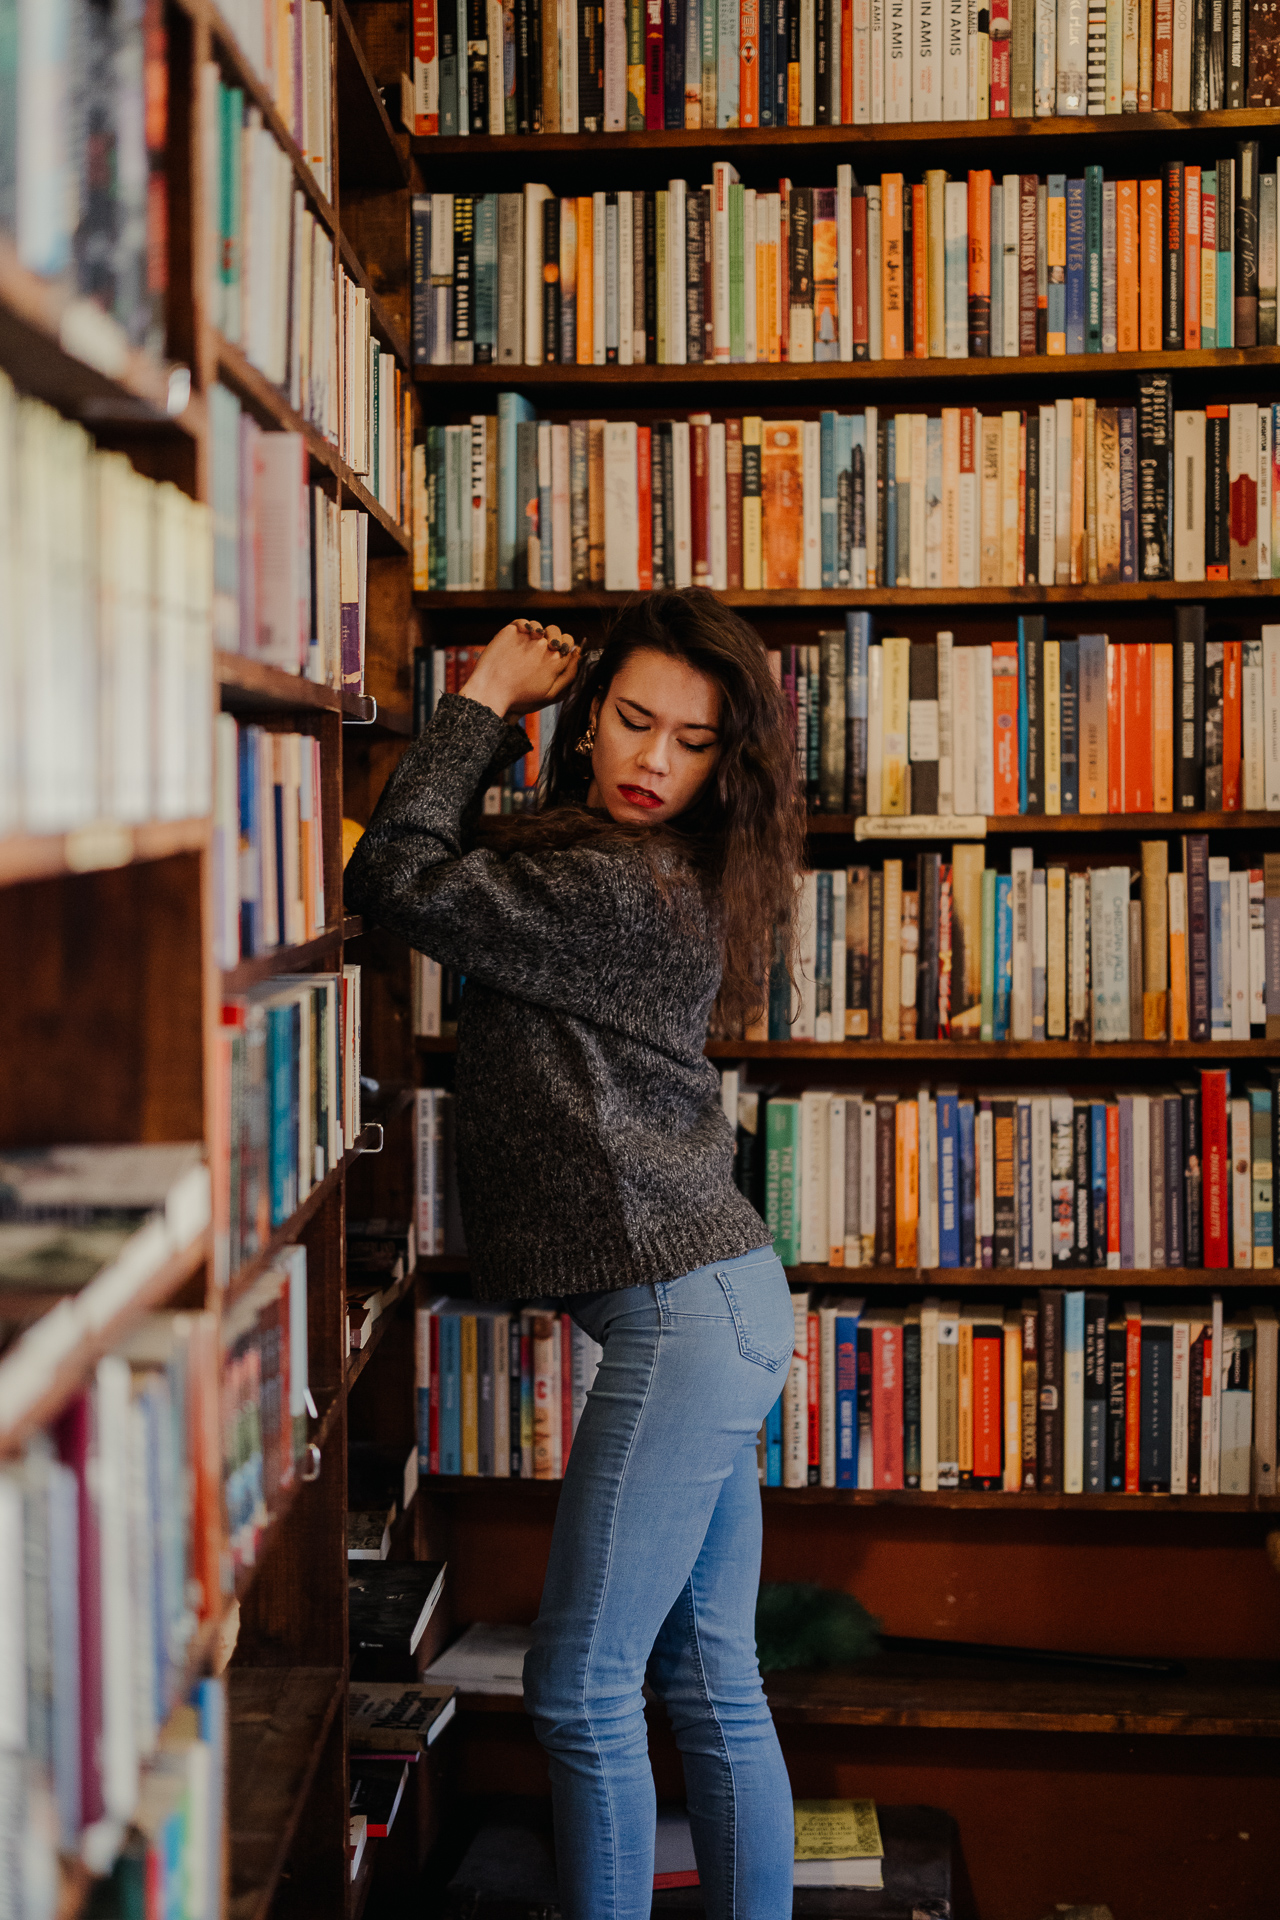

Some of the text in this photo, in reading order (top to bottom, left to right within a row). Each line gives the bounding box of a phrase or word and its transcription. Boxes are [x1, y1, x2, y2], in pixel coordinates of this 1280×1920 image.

[703, 16, 713, 56] PRETTY
[874, 6, 882, 31] AMIS
[891, 22, 903, 59] AMIS
[920, 21, 932, 58] AMIS
[950, 19, 961, 56] AMIS
[967, 11, 977, 35] AMIS
[1157, 22, 1171, 40] TALE
[1213, 1, 1222, 32] LEVIATHAN
[1231, 1, 1241, 67] THE NEW YORK TRILOGY
[992, 58, 1000, 83] ANAM
[1000, 51, 1008, 88] TAHMIMA
[792, 207, 808, 237] After
[1068, 188, 1083, 272] MIDWIVES
[1169, 168, 1181, 250] THE PASSENGER
[1186, 176, 1199, 235] THE PASSENGER
[1202, 216, 1216, 245] BOYLE
[796, 247, 809, 271] Fire
[1021, 196, 1036, 272] POSTMISTRESS
[1120, 203, 1138, 264] Guernica
[1144, 202, 1162, 264] Guernica
[1090, 252, 1099, 325] COWBOY GRAVES
[1204, 257, 1214, 271] THE
[456, 255, 469, 338] THE DARLING
[1021, 274, 1036, 342] SARAH BLAKE
[1140, 387, 1153, 439] DAVIES
[1151, 379, 1167, 446] ROBERTSON
[471, 423, 483, 490] HELL
[1101, 418, 1116, 471] ZABOR
[745, 452, 757, 491] CASEY
[1120, 436, 1134, 512] BOHEMIANS
[1140, 458, 1158, 538] CUNNING MAN
[810, 705, 819, 748] EASTON
[810, 750, 819, 781] ELLIS
[768, 1149, 779, 1233] NOTEBOOK
[782, 1146, 793, 1240] THE GOLDEN
[1110, 1361, 1125, 1419] ELMET
